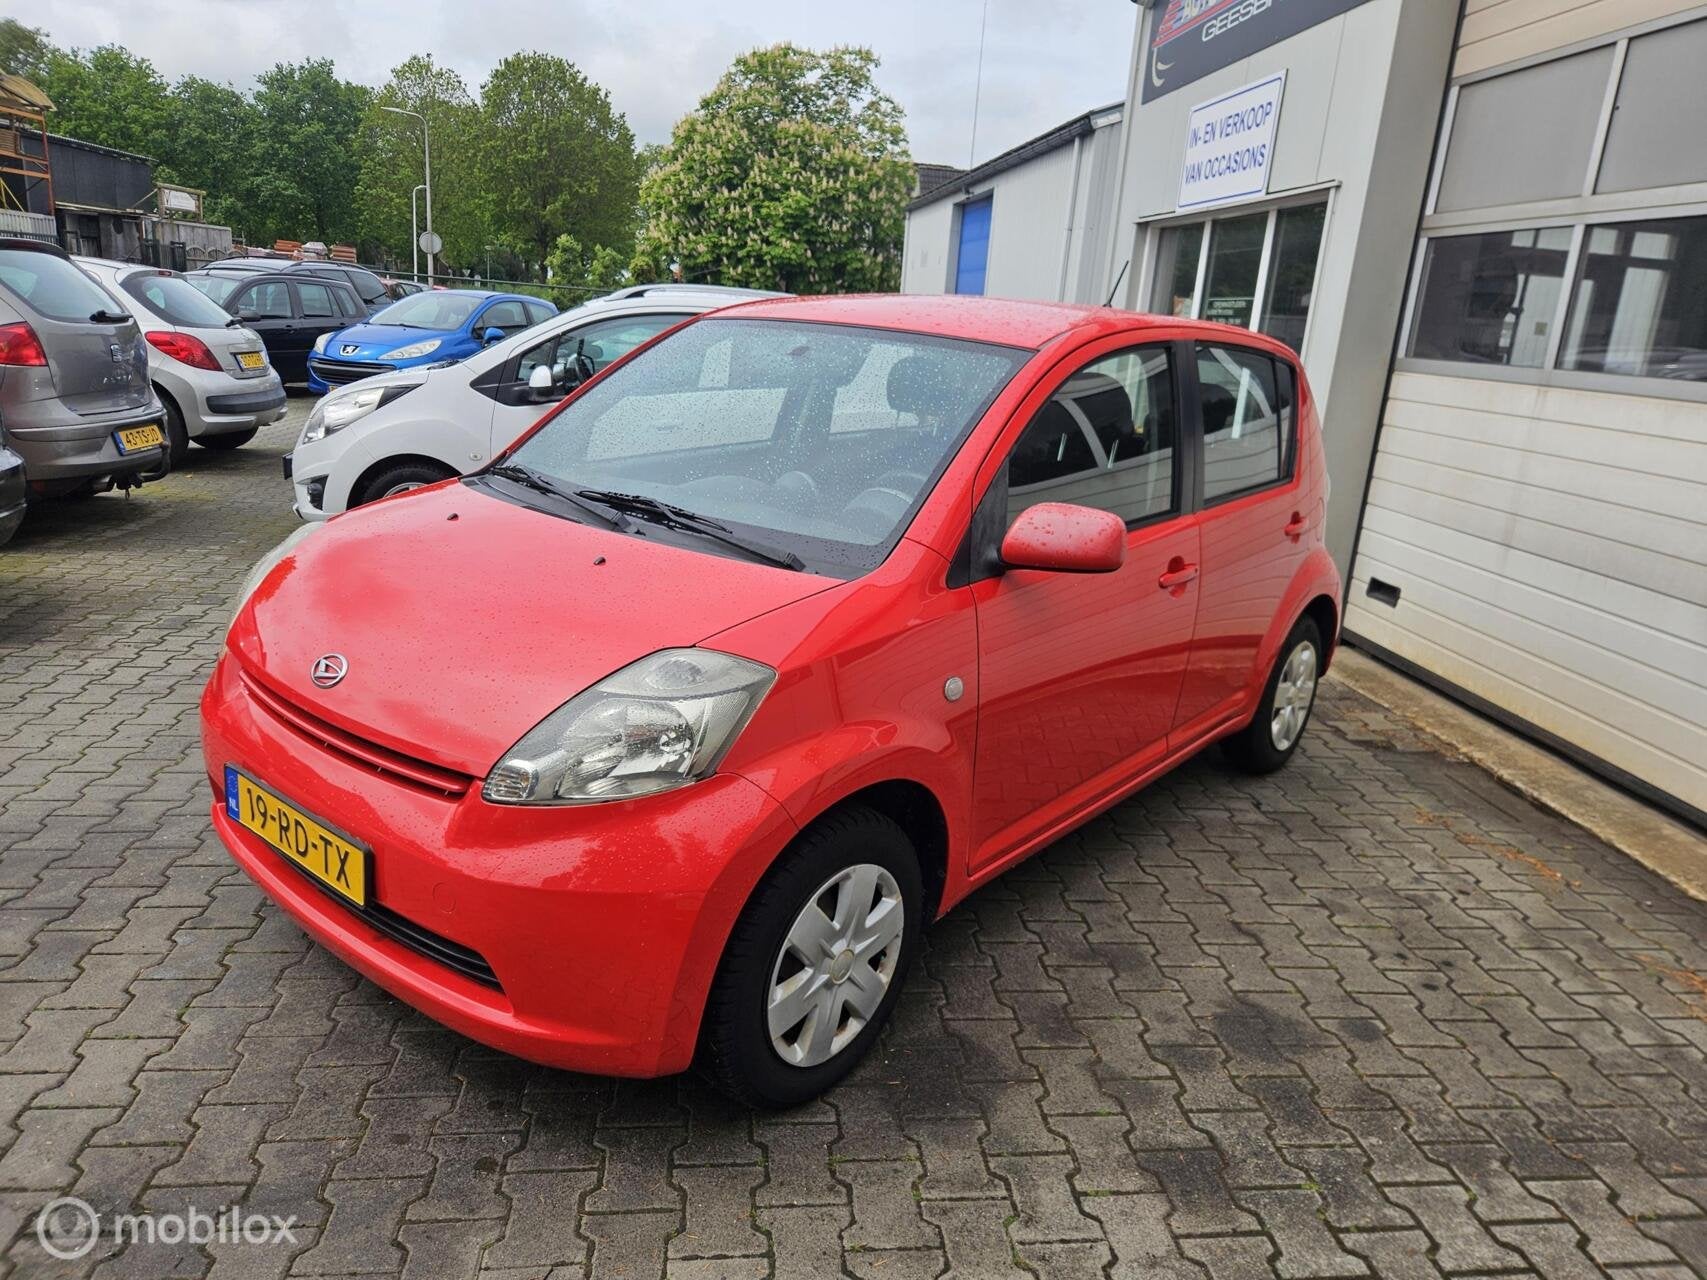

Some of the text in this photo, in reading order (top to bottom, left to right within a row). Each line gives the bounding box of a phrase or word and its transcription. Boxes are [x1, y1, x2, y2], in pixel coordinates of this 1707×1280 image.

[1202, 0, 1272, 41] GEESB
[1190, 101, 1273, 148] IN- EN VERKOOP
[1185, 143, 1266, 184] VAN OCCASIONS
[246, 787, 351, 889] 19-RD-TX
